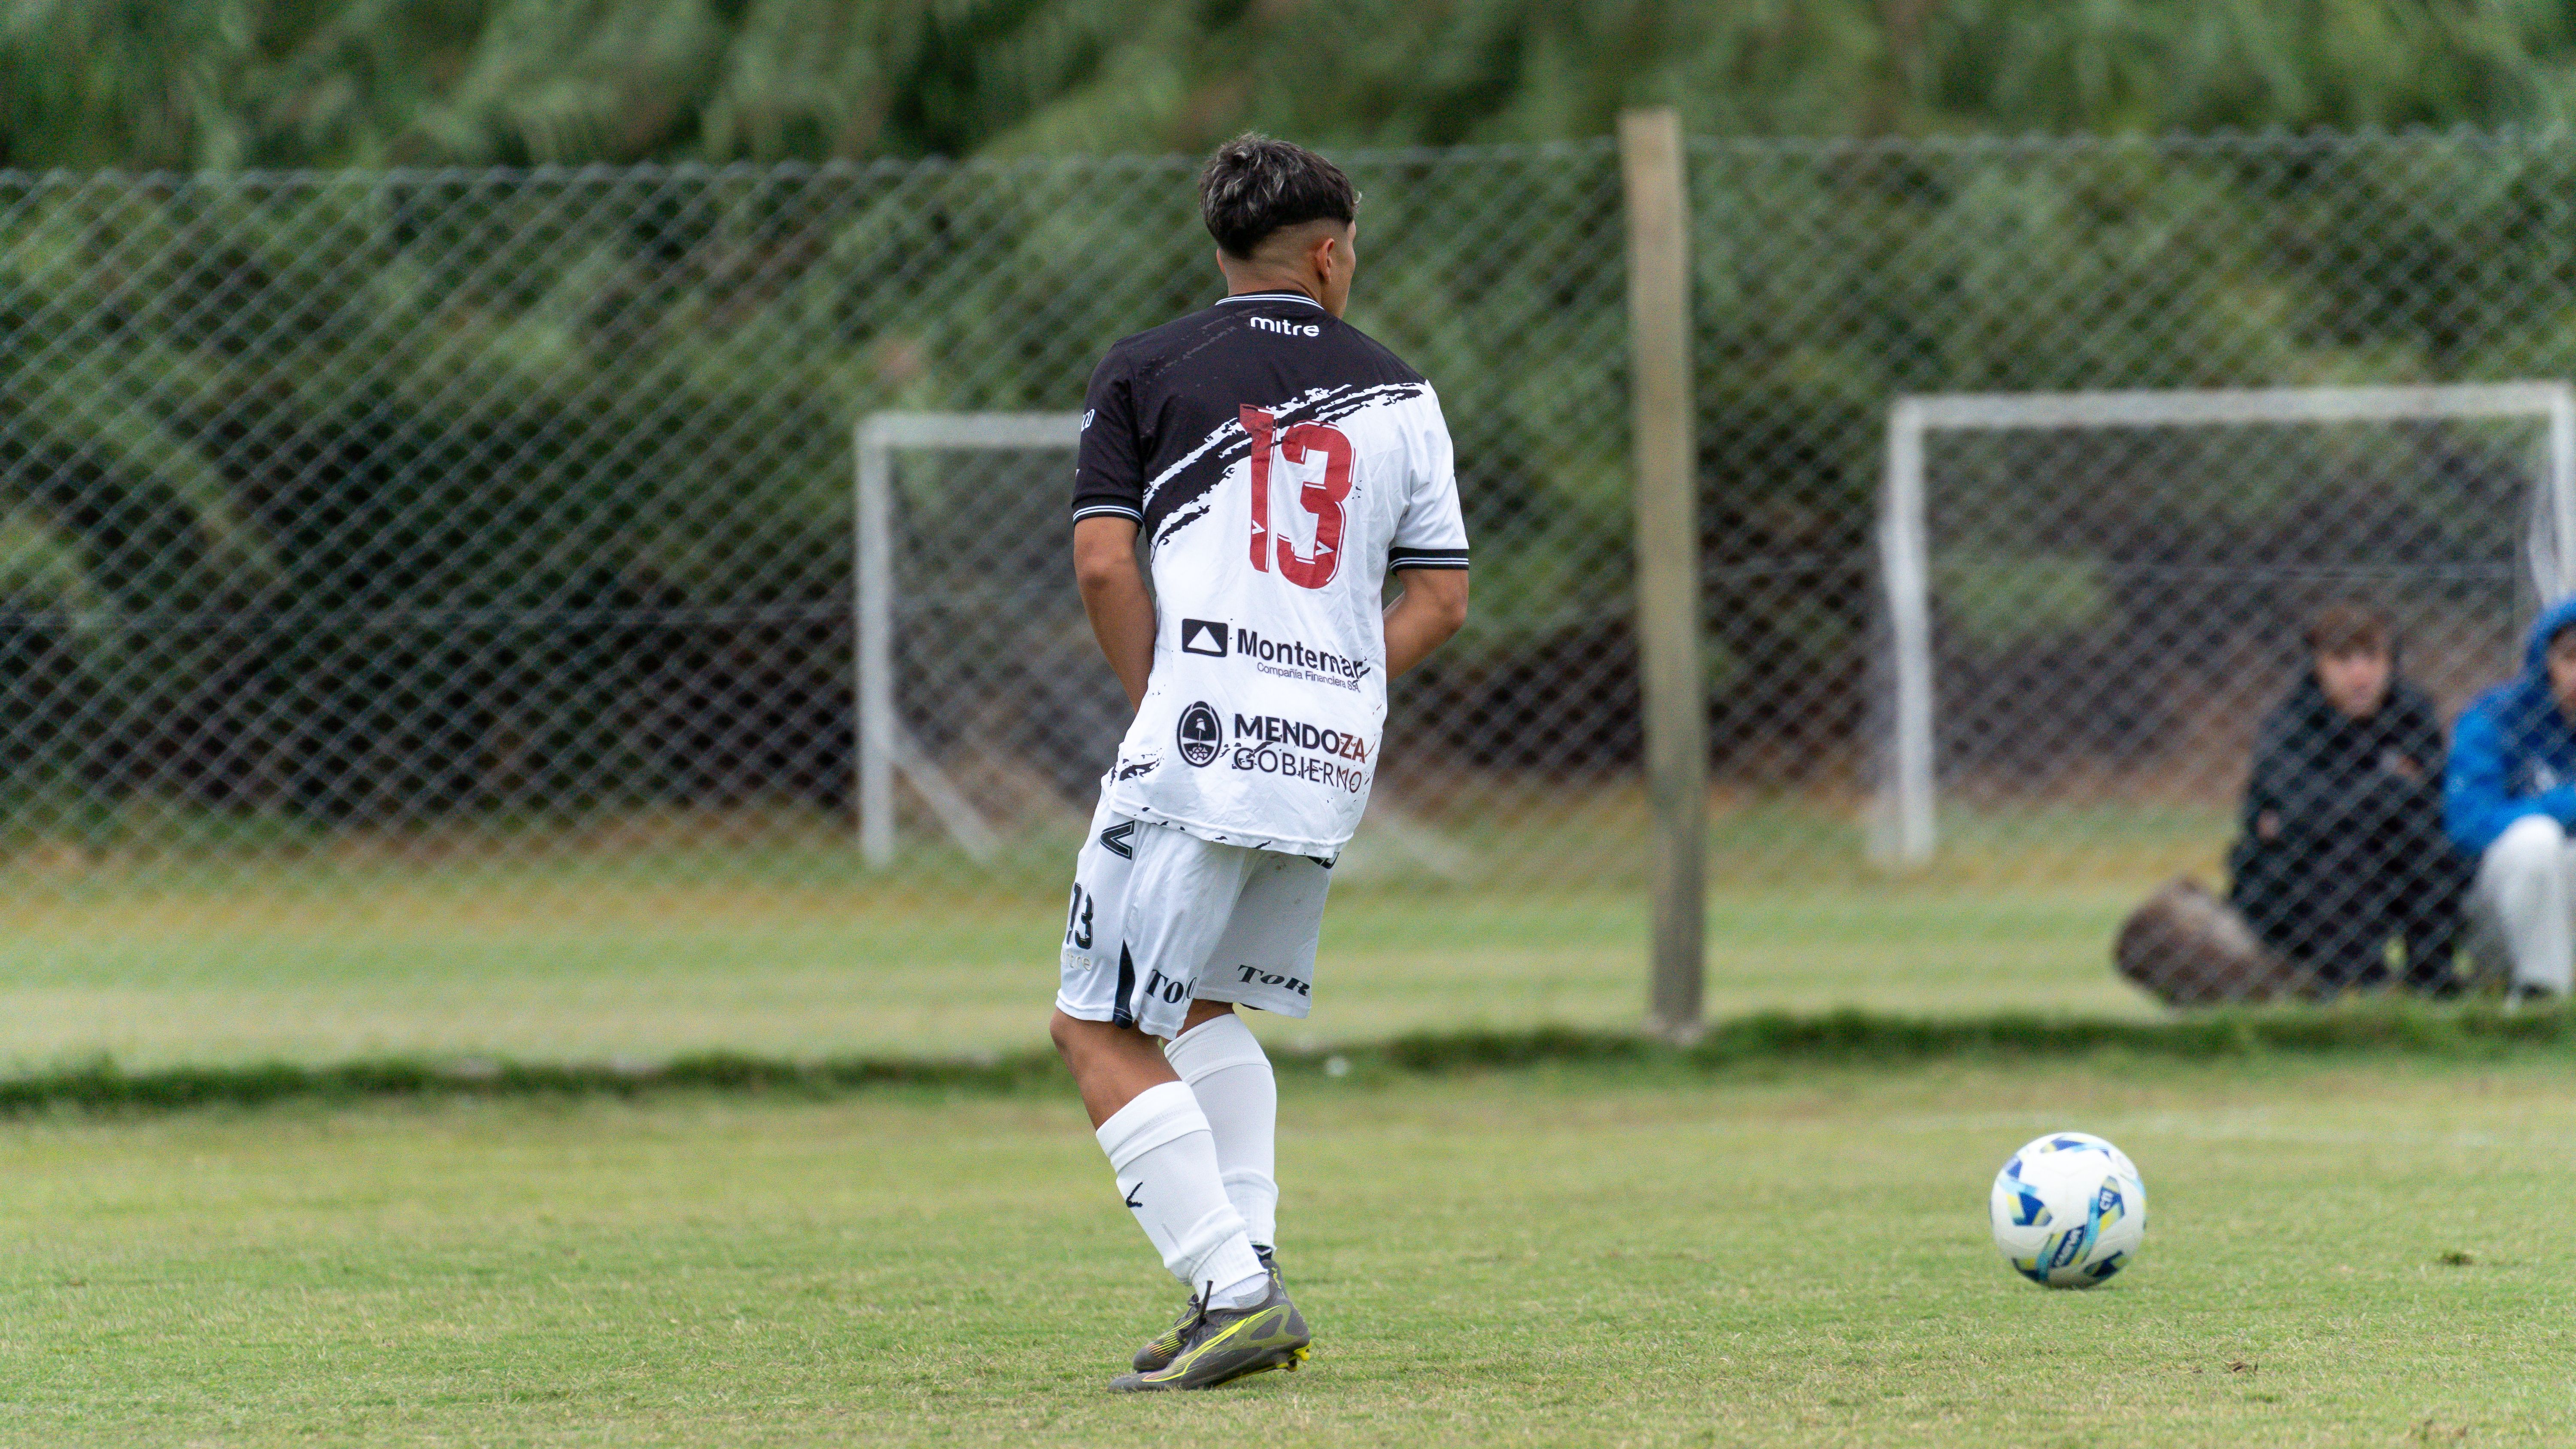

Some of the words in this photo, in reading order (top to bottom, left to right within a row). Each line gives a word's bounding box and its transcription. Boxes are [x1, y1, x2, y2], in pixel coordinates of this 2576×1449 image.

[1250, 317, 1319, 337] mitre
[1239, 403, 1356, 589] 13
[1237, 628, 1364, 679] Montemar
[1257, 662, 1303, 679] Compañía
[1305, 670, 1346, 688] Financiera
[1234, 713, 1366, 764] MENDOZA
[1233, 747, 1362, 794] GOBIERNO
[1066, 882, 1094, 950] 13
